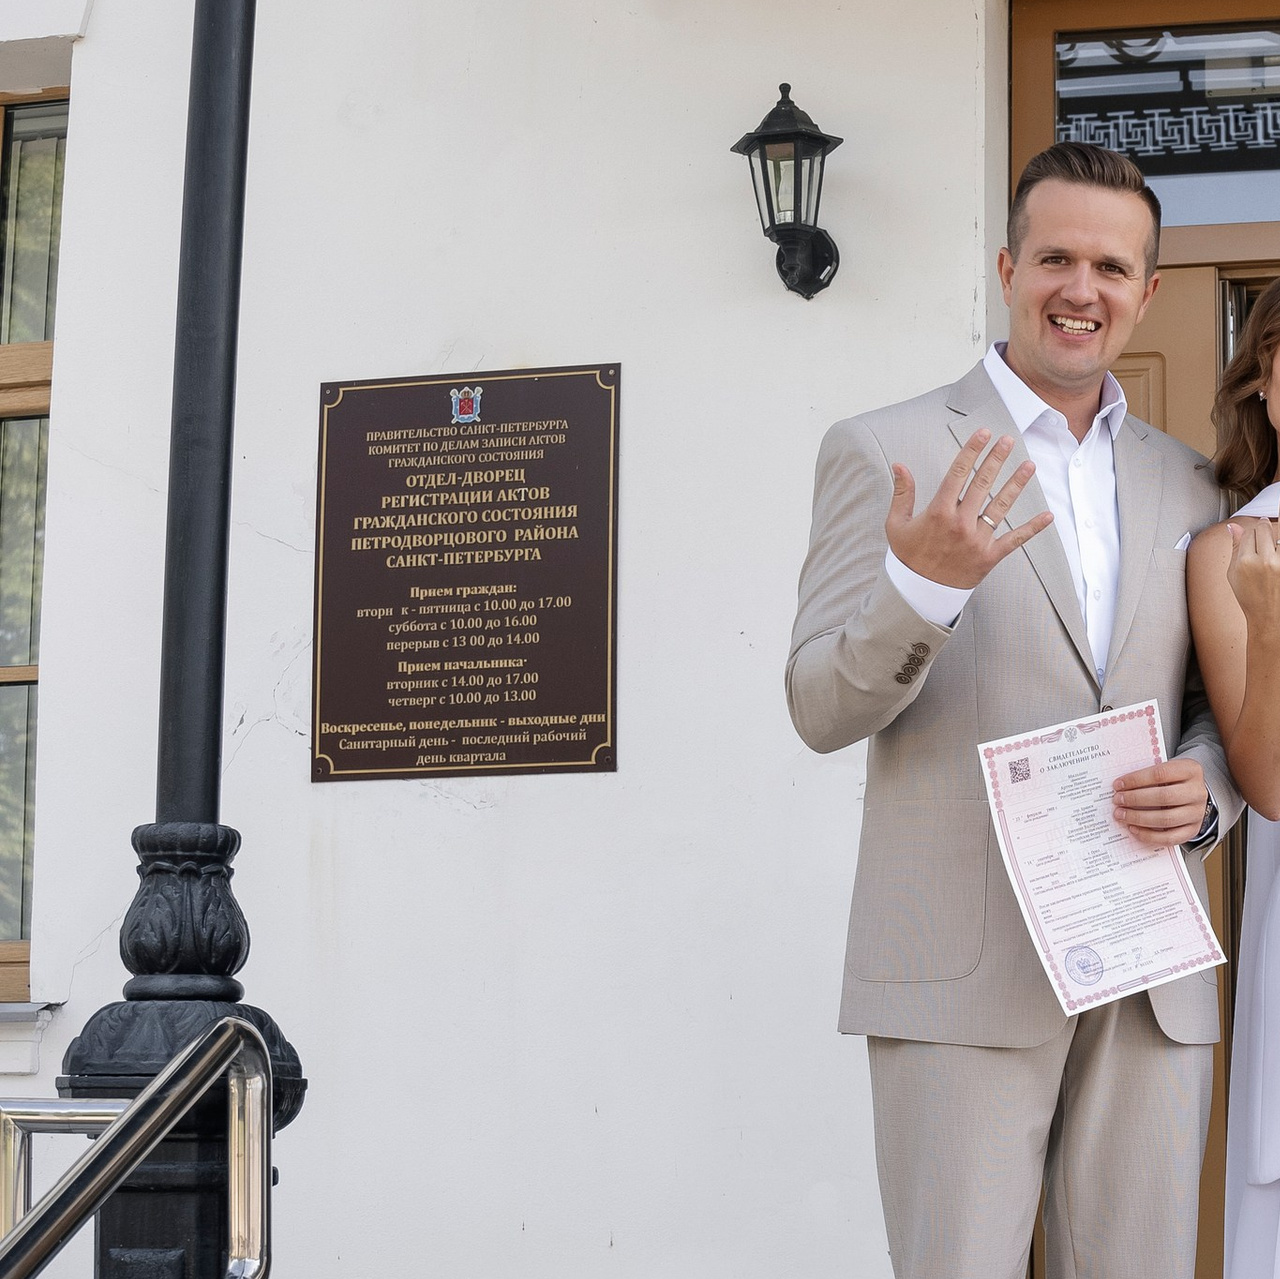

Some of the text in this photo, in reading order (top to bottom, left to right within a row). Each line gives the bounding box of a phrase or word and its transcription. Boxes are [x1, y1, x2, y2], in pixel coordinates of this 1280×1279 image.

[366, 420, 569, 442] ПРАВИТЕЛЬСТВО САНКТ-ПЕТЕРБУРГА
[368, 433, 566, 456] КОМИТЕТ ПО ДЕЛАМ ЗАПИСИ АКТОВ
[388, 449, 544, 469] ГРАЖДАНСКОГО СОСТОЯНИЯ
[405, 468, 526, 490] ОТДЕЛ-ДВОРЕЦ
[381, 486, 550, 509] РЕГИСТРАЦИИ АКТОВ
[353, 504, 578, 531] ГРАЖДАНСКОГО СОСТОЯНИЯ
[351, 525, 579, 551] ПЕТРОДВОРЦОВОГО РАЙОНА
[386, 547, 542, 569] САНКТ-ПЕТЕРБУРГА
[410, 584, 517, 601] Прием граждан:
[418, 603, 471, 615] пятница
[474, 603, 481, 612] с
[483, 598, 517, 611] 10.00
[518, 600, 535, 612] до
[538, 595, 572, 609] 17.00
[388, 614, 537, 636] суббота с 10.00 до 16.00
[386, 639, 440, 653] перерыв
[442, 639, 450, 648] с
[486, 636, 504, 648] до
[506, 632, 540, 645] 14.00
[398, 661, 441, 675] Прием
[386, 672, 539, 692] вторник с 14.00 до 17.00
[388, 689, 537, 709] четверг с 10.00 до 13.00
[321, 721, 407, 736] Воскресенье,
[409, 718, 498, 731] понедельник
[508, 714, 577, 727] выходные
[579, 713, 606, 726] дни
[338, 735, 416, 752] Санитарный
[418, 737, 449, 749] день
[462, 730, 530, 746] последний
[533, 728, 587, 745] рабочий
[416, 750, 507, 766] день квартала
[1046, 757, 1090, 772] ЗАКЛЮЧЕНИИ
[1090, 750, 1111, 760] БРАКА
[1048, 744, 1100, 763] СВИДЕТЕЛЬСТВО
